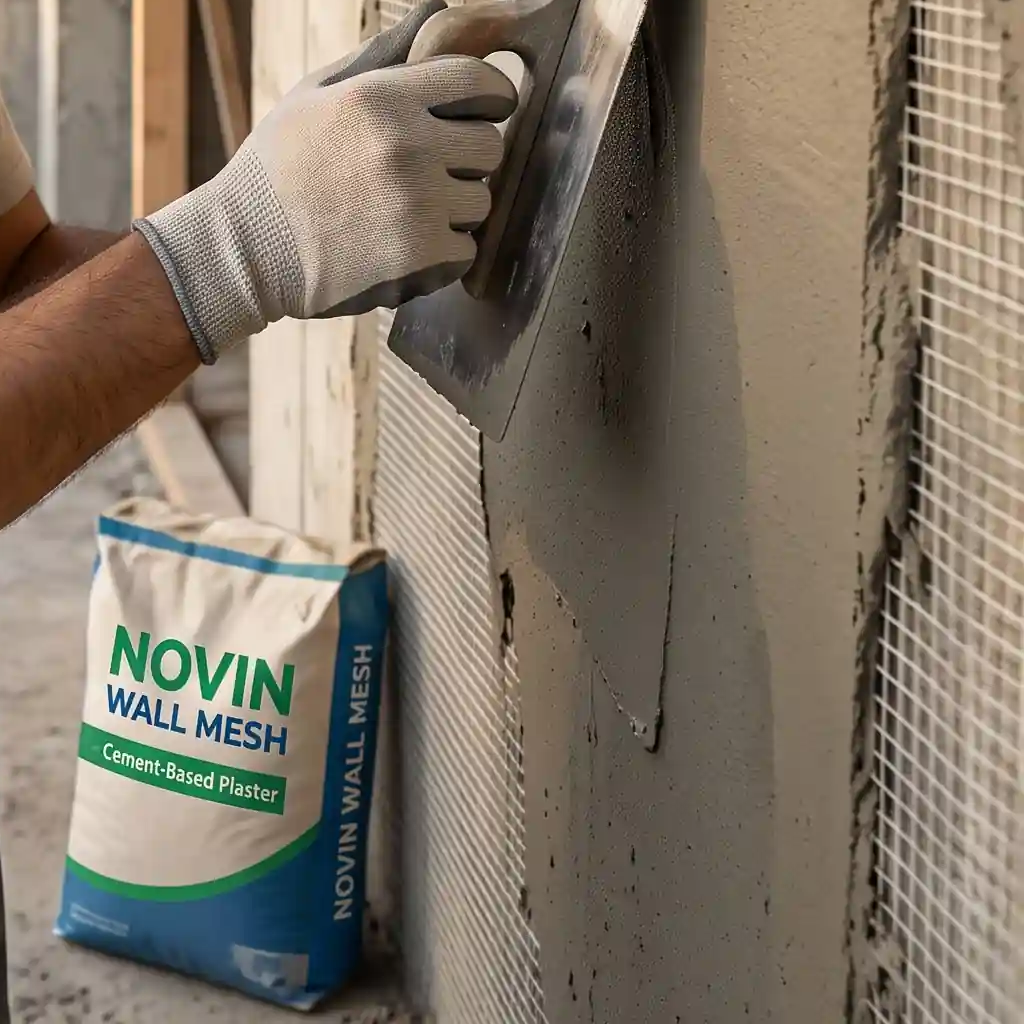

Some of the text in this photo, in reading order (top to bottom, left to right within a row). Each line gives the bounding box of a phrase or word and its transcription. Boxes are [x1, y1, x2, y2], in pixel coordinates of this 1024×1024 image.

[109, 624, 295, 717] NOVIN
[106, 683, 288, 757] WALL MESH
[102, 742, 279, 804] Cement-Based Plaster
[333, 644, 374, 921] NOVIN WALL MESH
